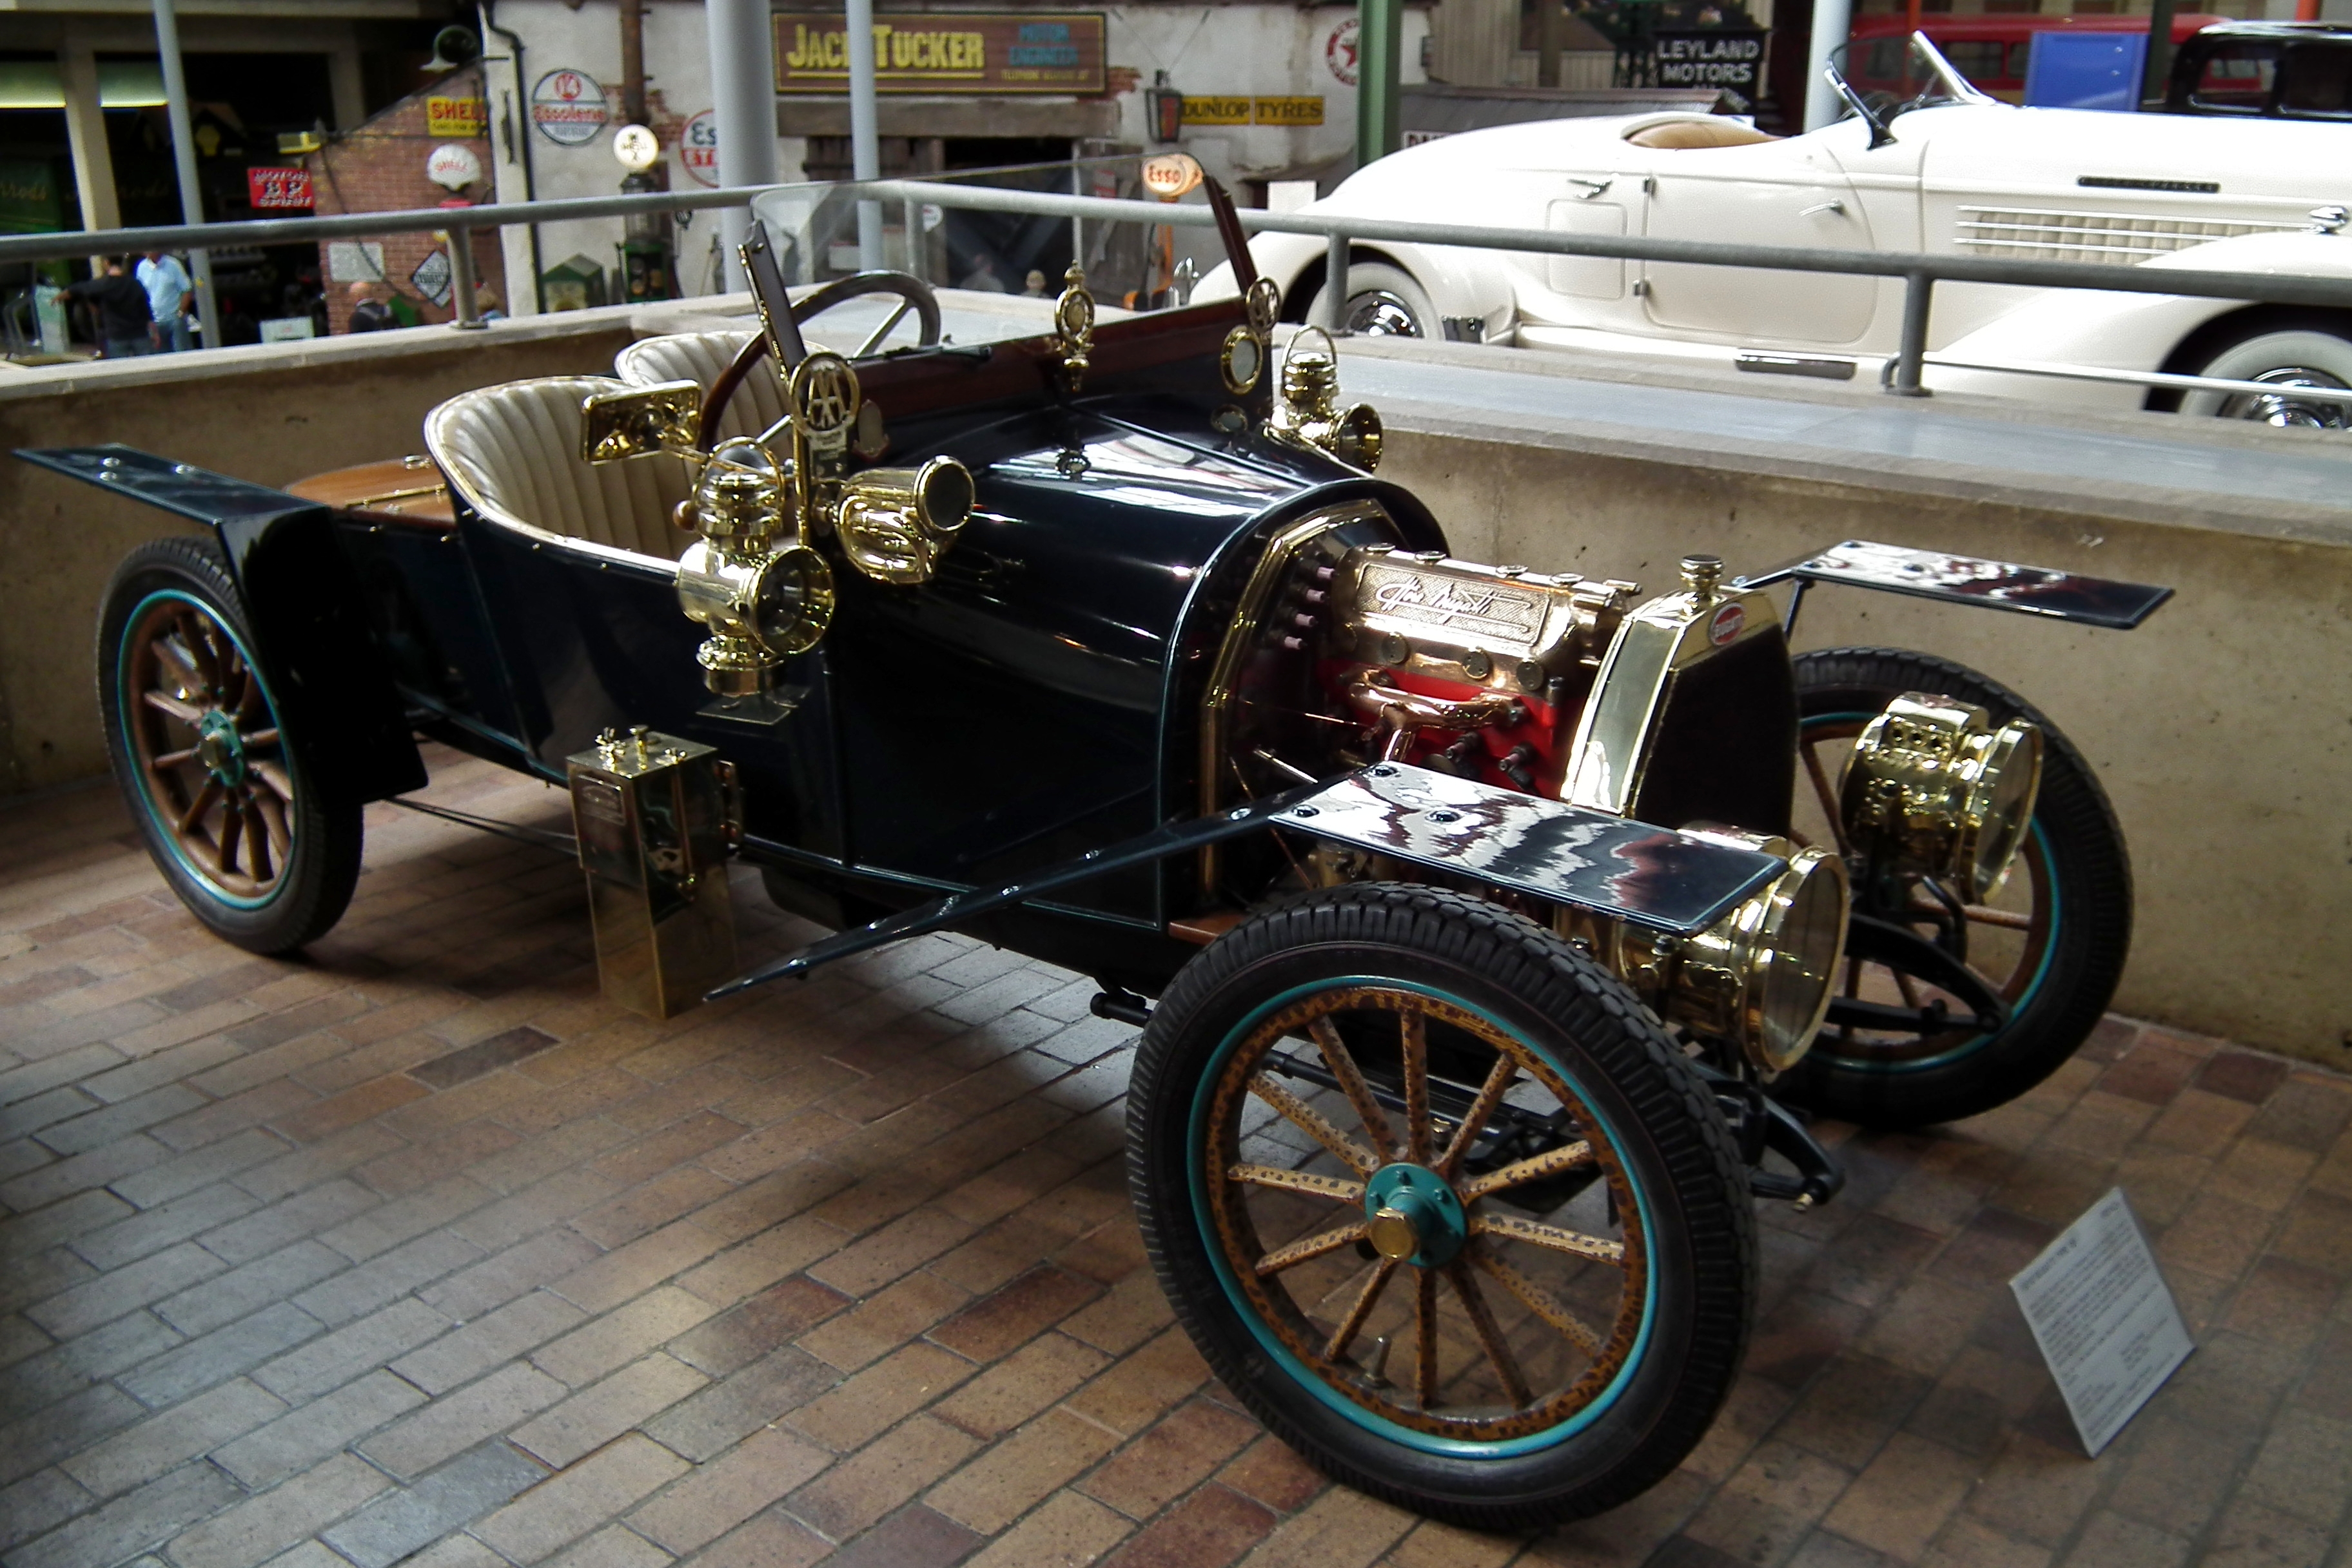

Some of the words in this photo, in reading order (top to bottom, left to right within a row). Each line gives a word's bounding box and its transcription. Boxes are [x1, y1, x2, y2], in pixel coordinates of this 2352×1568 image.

[872, 24, 985, 68] TUCKER
[1656, 39, 1760, 59] LEYLAND
[1661, 63, 1752, 83] MOTORS
[1182, 101, 1250, 118] DUNLOP
[1255, 101, 1323, 118] TYRES
[435, 161, 469, 173] SHELL
